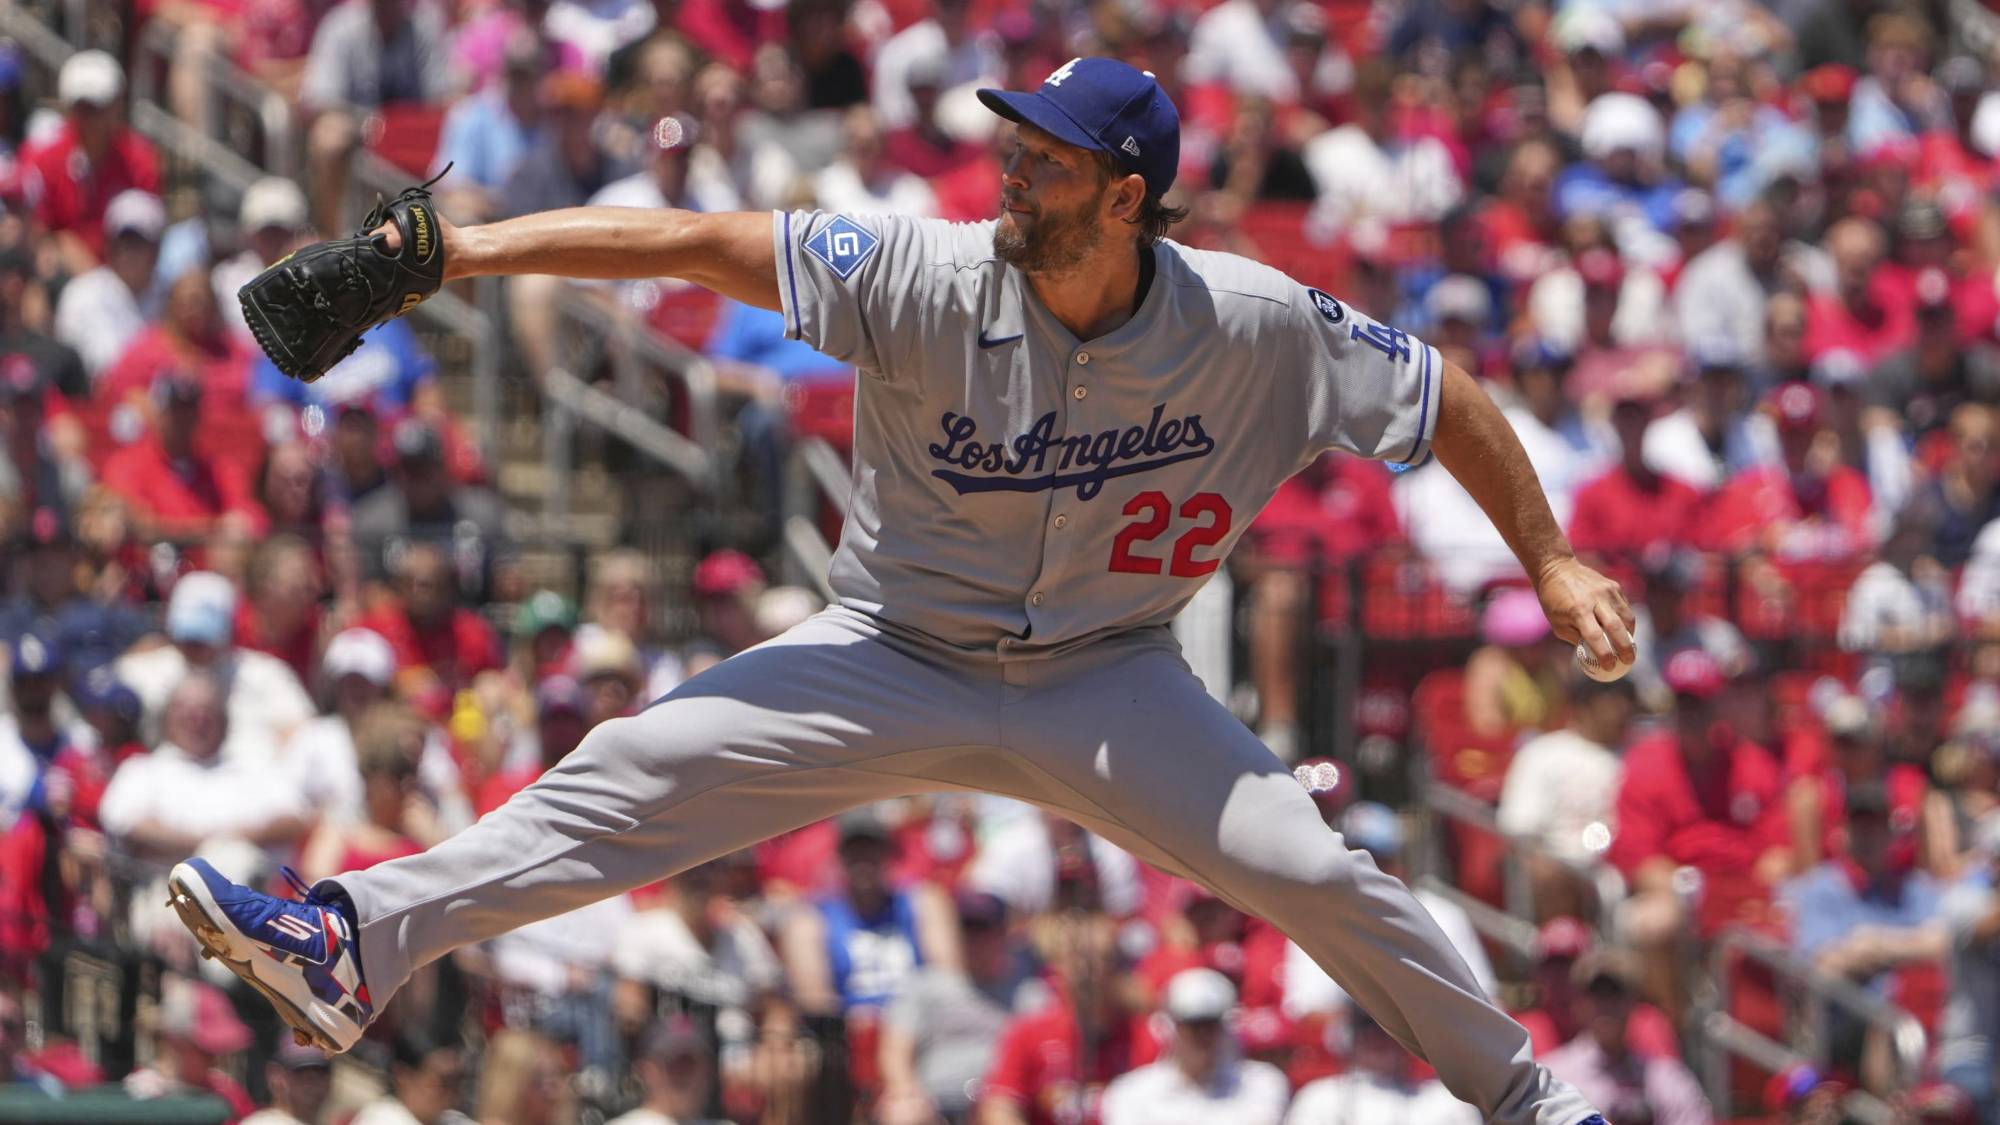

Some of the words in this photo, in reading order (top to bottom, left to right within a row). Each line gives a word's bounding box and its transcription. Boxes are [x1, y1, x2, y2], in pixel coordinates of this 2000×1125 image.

[409, 206, 430, 256] Wilson
[1351, 323, 1410, 363] LA
[929, 411, 1003, 473] Los
[1004, 402, 1214, 501] Angeles
[1108, 490, 1232, 577] 22
